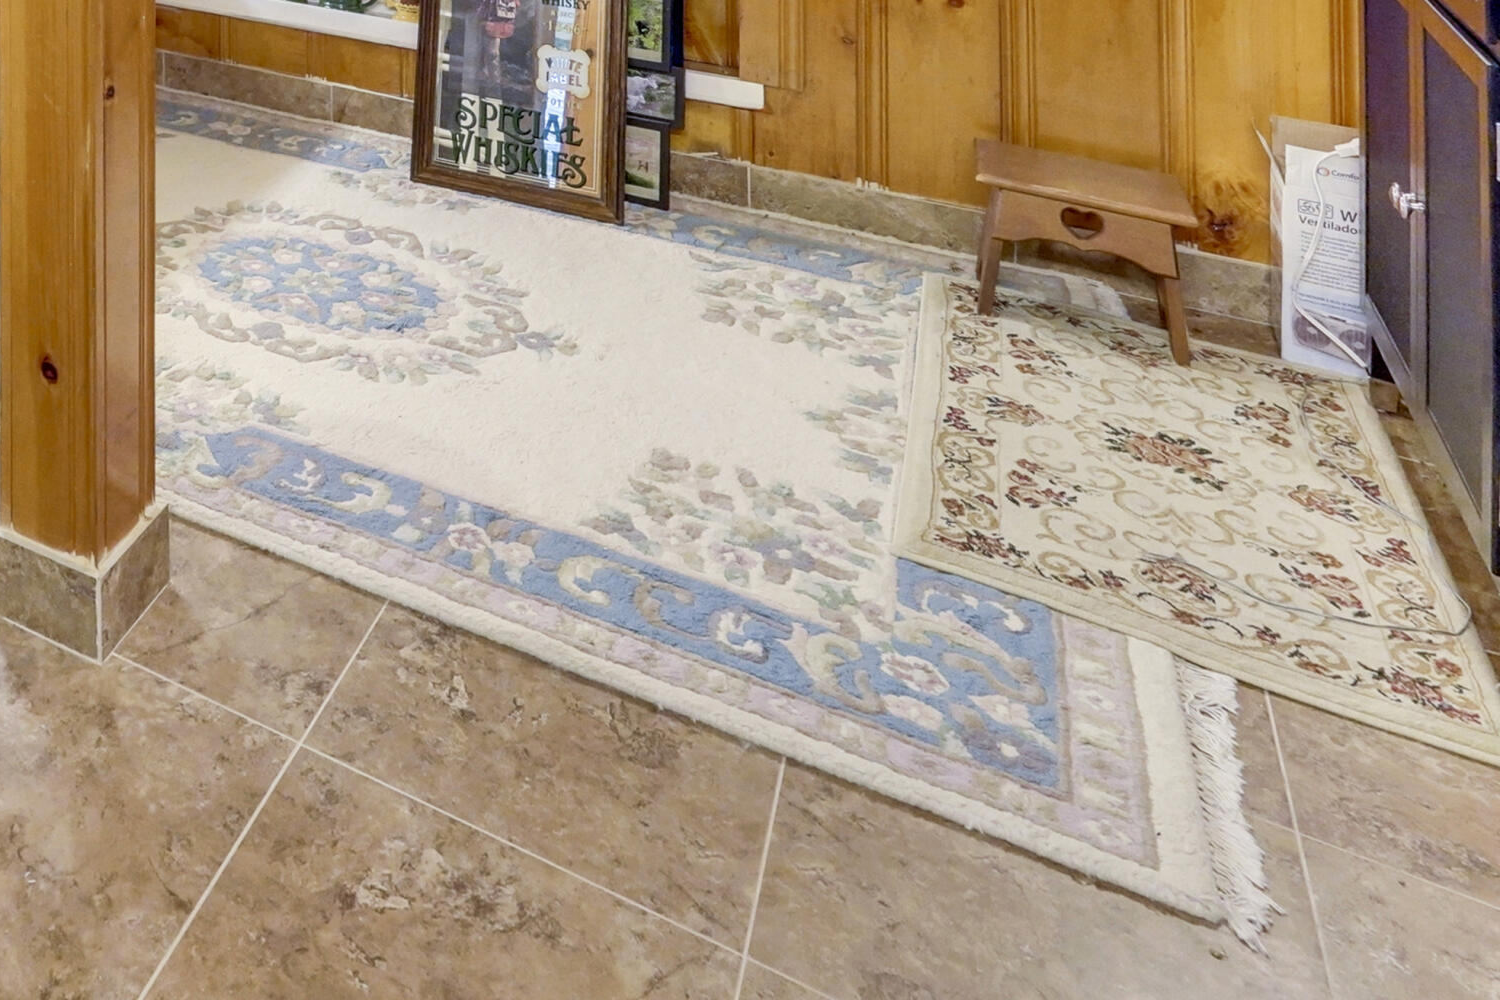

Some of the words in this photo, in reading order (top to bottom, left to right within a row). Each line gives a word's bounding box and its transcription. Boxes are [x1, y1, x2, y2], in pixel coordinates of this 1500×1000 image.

[545, 57, 583, 74] WHITE
[546, 73, 583, 87] LABEL
[456, 96, 583, 147] SPECIAL
[452, 128, 587, 188] WHISKIES
